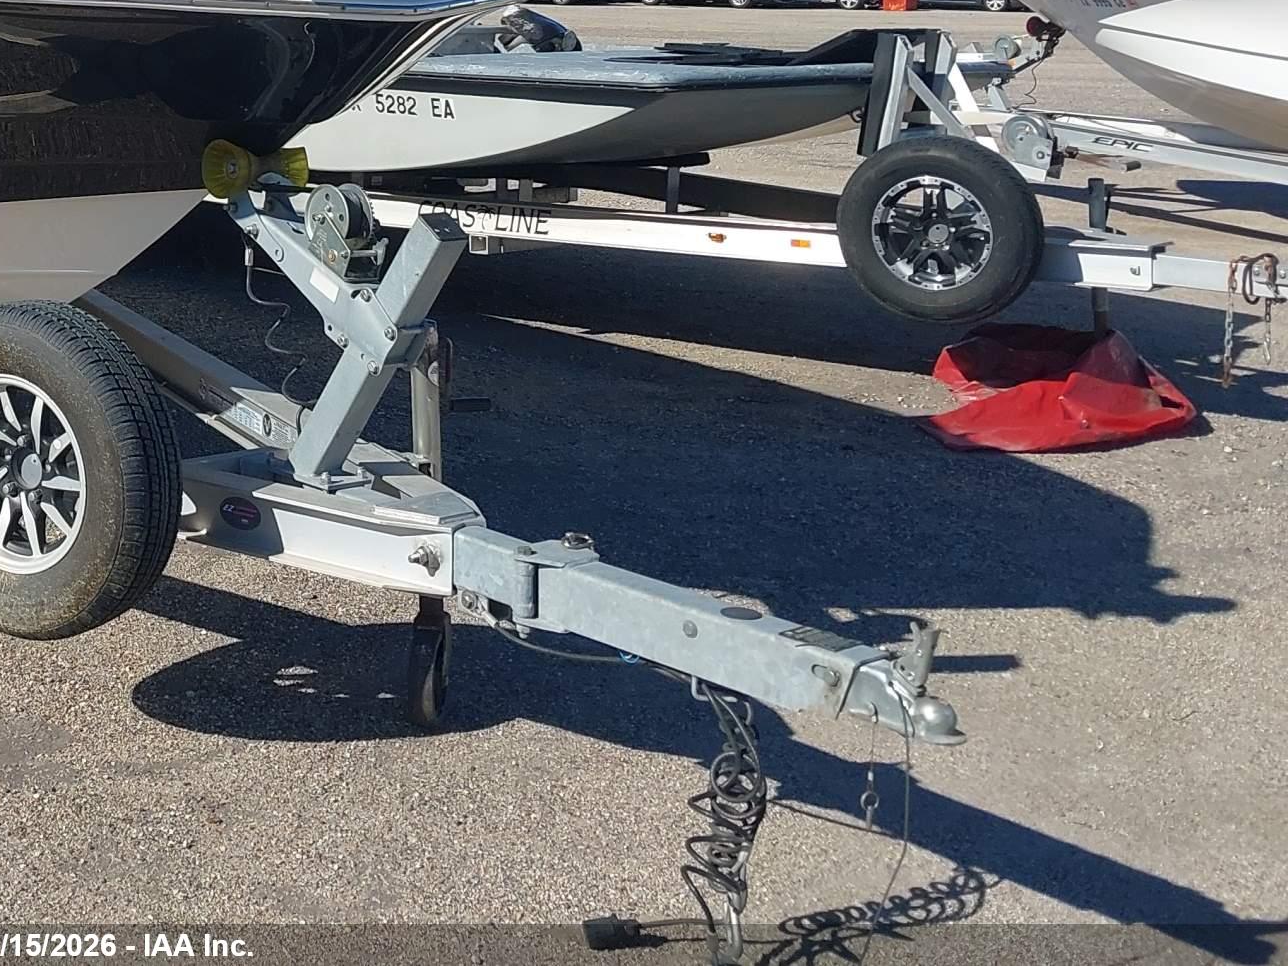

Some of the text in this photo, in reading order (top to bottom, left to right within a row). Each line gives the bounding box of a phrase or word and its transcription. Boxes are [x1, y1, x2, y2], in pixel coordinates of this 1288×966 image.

[375, 94, 455, 119] 5282 EA
[1092, 136, 1154, 153] EPIC
